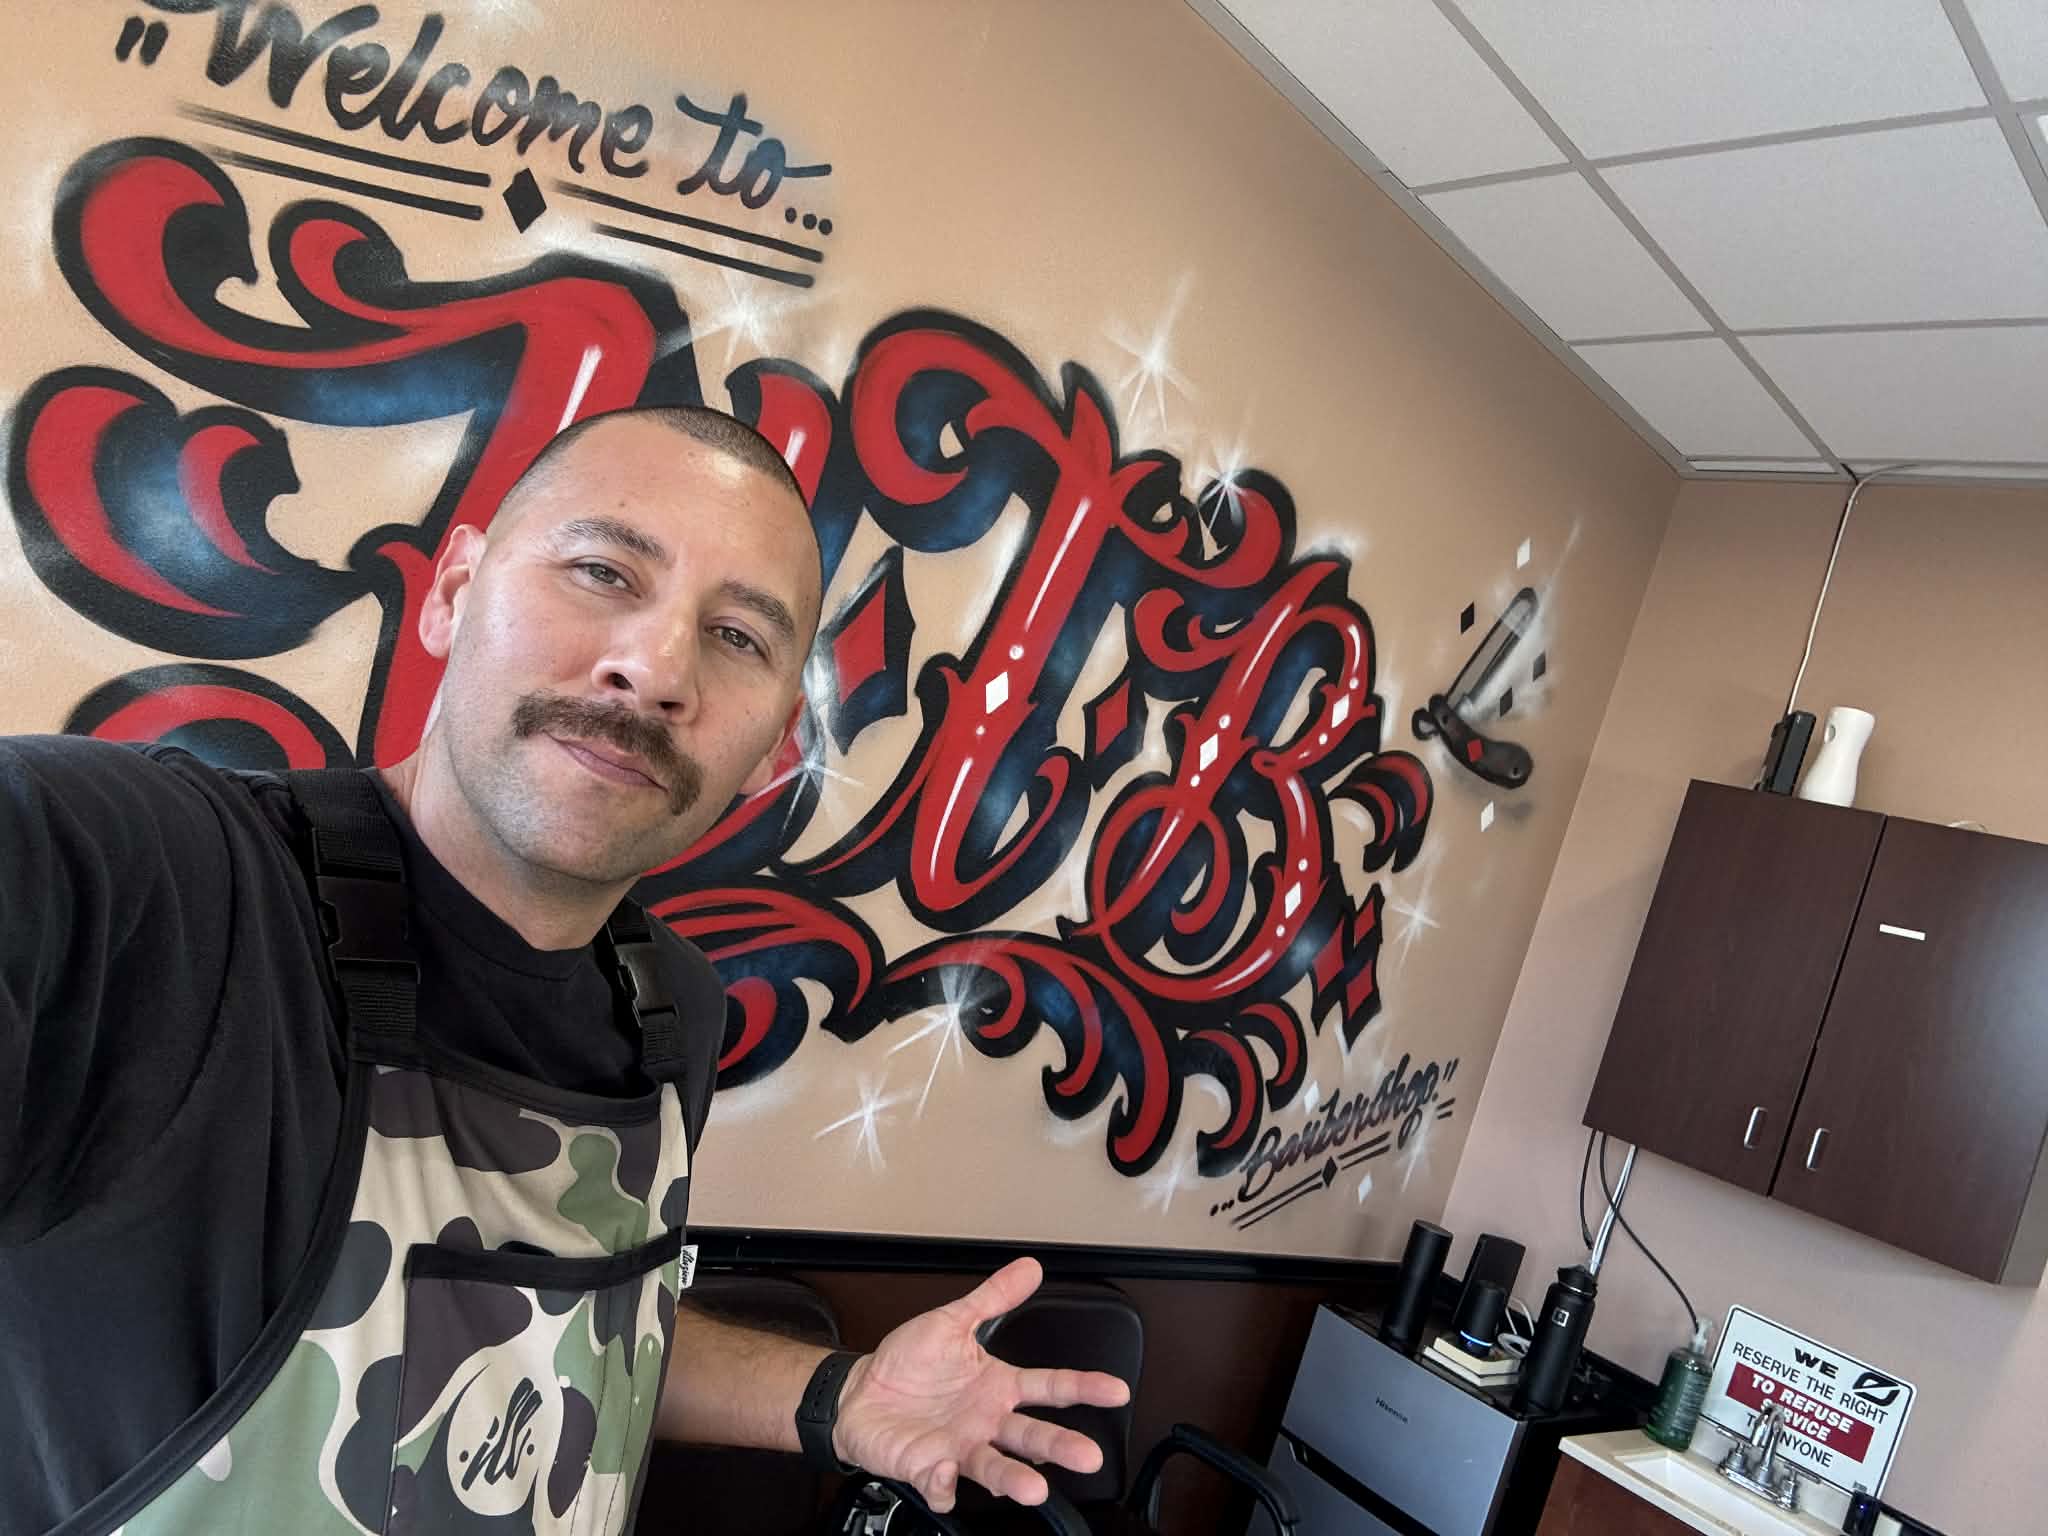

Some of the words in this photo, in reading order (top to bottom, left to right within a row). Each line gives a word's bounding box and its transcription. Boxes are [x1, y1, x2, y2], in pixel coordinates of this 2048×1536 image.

[1732, 1341, 1801, 1384] RESERVE
[1806, 1374, 1836, 1401] THE
[1839, 1392, 1889, 1425] RIGHT
[1794, 1347, 1839, 1379] WE
[1752, 1373, 1776, 1395] TO
[1779, 1387, 1854, 1433] REFUSE
[1760, 1398, 1831, 1442] SRVICE
[1779, 1430, 1833, 1468] NYONE
